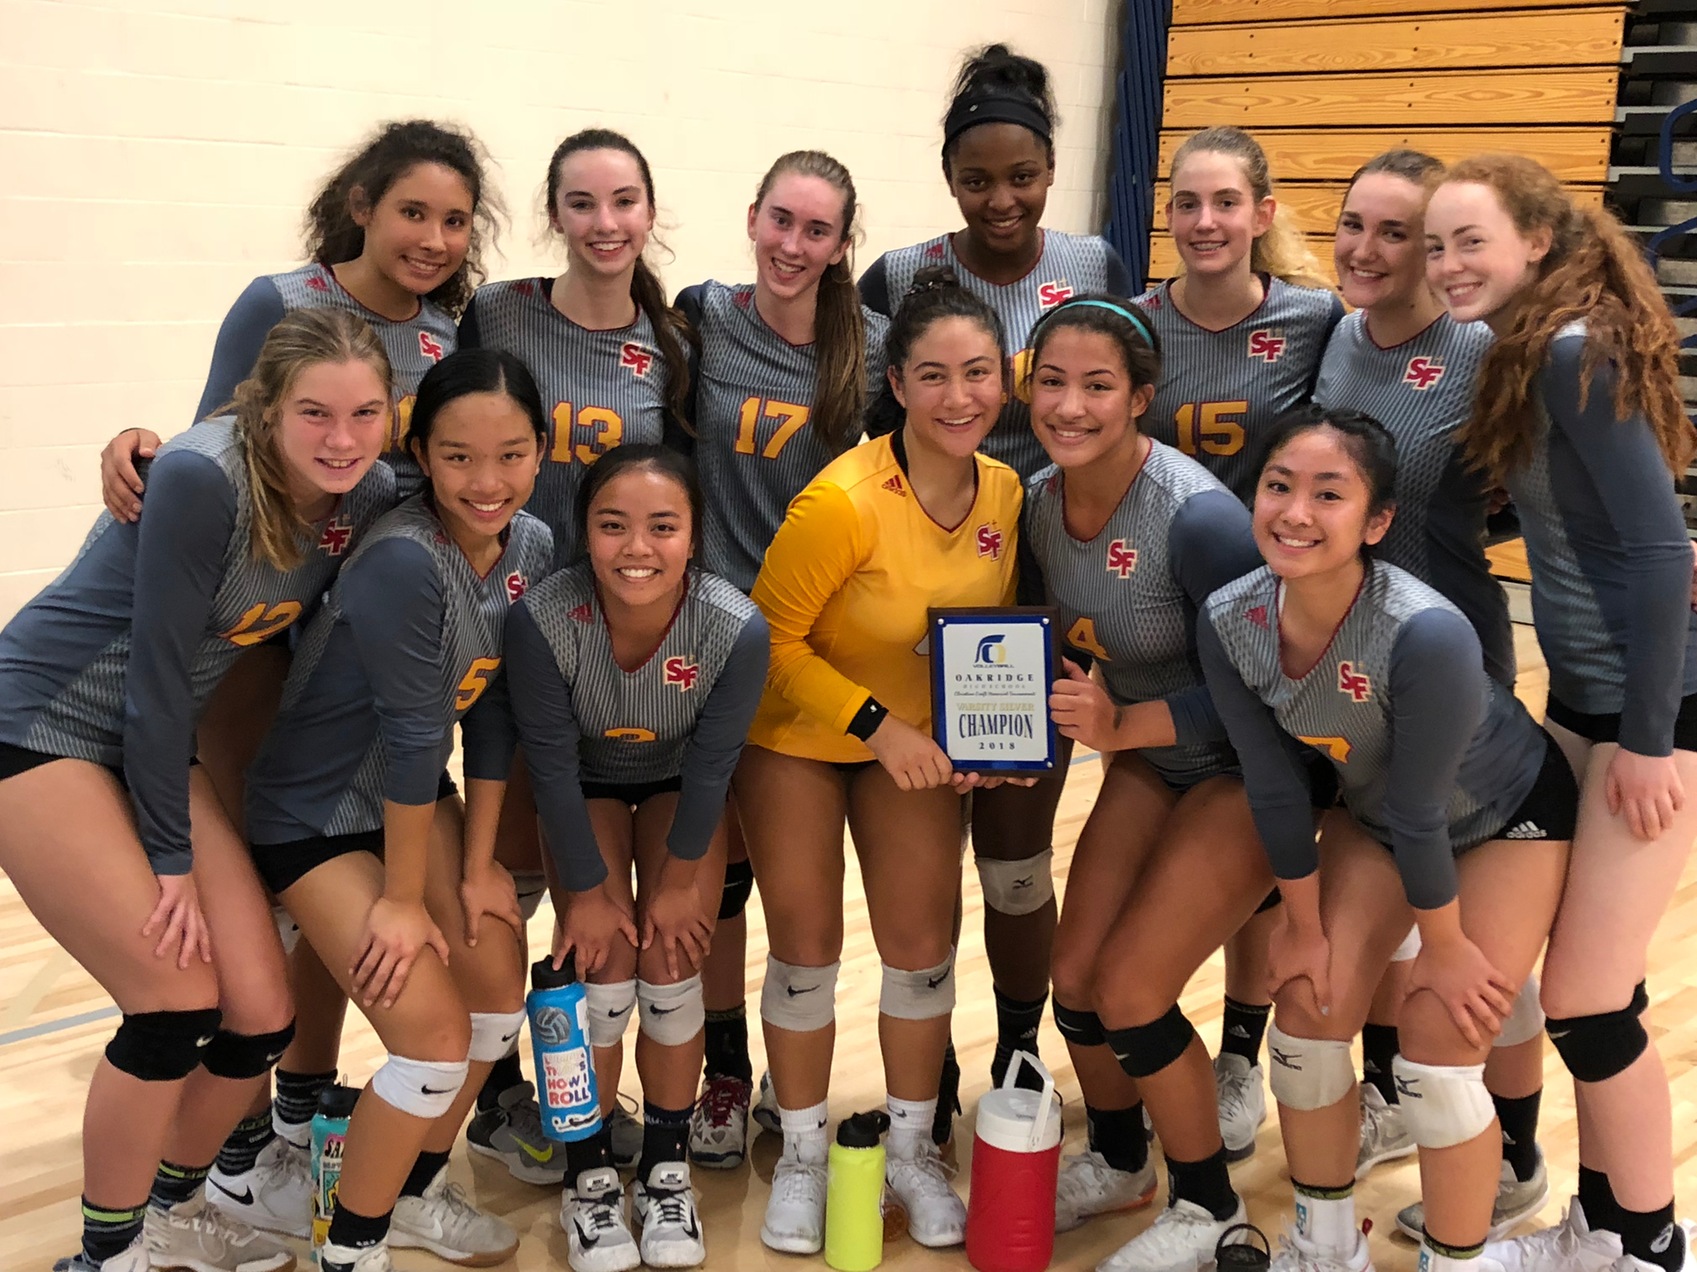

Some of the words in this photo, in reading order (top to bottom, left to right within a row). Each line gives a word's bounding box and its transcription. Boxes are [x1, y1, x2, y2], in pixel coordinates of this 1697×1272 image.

[620, 341, 653, 378] SF
[1248, 329, 1286, 363] SF
[1402, 356, 1446, 390] SF
[550, 401, 623, 466] 13
[735, 396, 811, 460] 17
[1174, 400, 1248, 456] 15
[317, 517, 354, 556] SF
[976, 522, 1002, 562] SF
[1106, 538, 1138, 579] SF
[216, 600, 303, 646] 12
[1066, 616, 1112, 661] 4
[455, 657, 501, 711] 5
[663, 655, 700, 693] SF
[955, 673, 1034, 682] OAKRIDGE
[1338, 661, 1373, 702] SF
[956, 703, 997, 711] VARSITY
[1000, 703, 1035, 712] SILVER
[958, 714, 1033, 740] CHAMPION
[979, 742, 1015, 750] 2018
[1506, 830, 1548, 839] adidas
[547, 1075, 581, 1091] HOW
[549, 1088, 591, 1105] ROLL
[324, 1138, 345, 1158] SA
